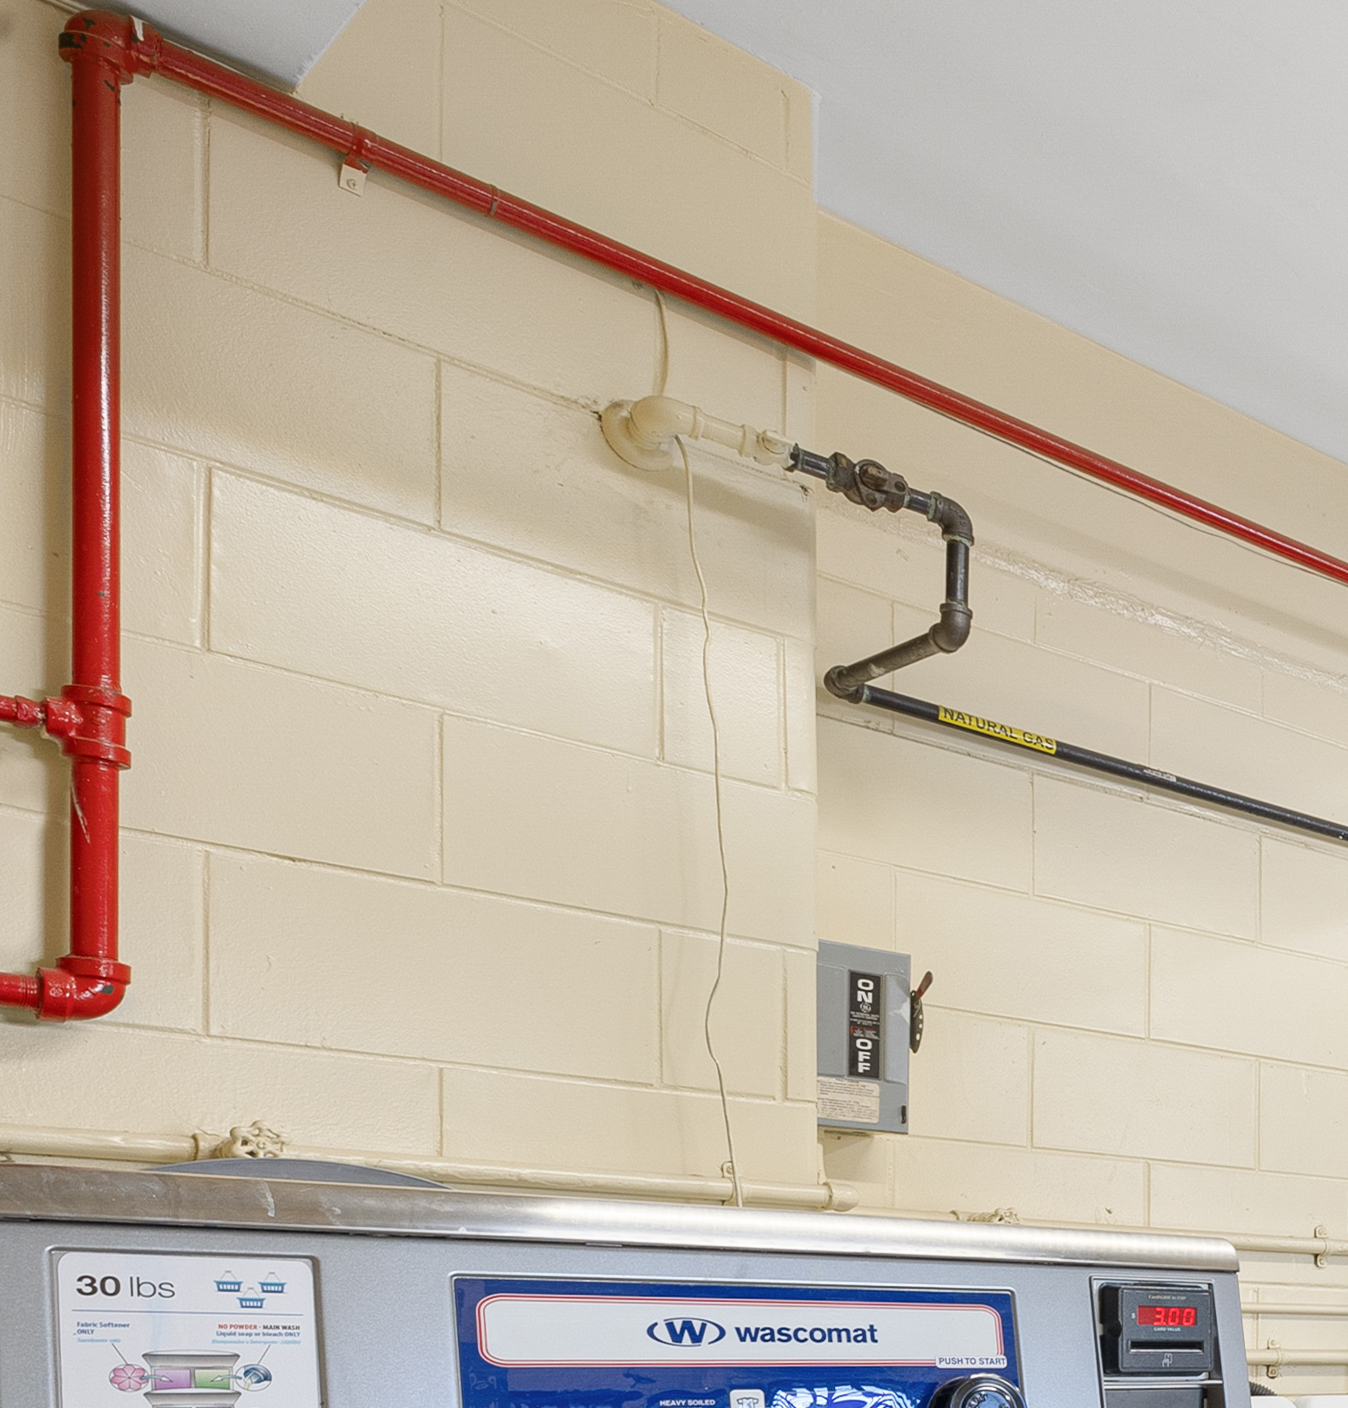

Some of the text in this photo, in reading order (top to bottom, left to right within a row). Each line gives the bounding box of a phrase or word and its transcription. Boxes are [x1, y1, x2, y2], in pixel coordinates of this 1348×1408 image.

[943, 707, 1054, 750] NATURAL GAS
[857, 979, 874, 1003] ON
[856, 1038, 872, 1073] OFF
[76, 1275, 176, 1299] 30 lbs
[1153, 1307, 1196, 1326] 3.00
[735, 1323, 878, 1344] wascomat
[938, 1356, 1006, 1366] PUSH TO START
[659, 1399, 716, 1407] HEAVY SOILED
